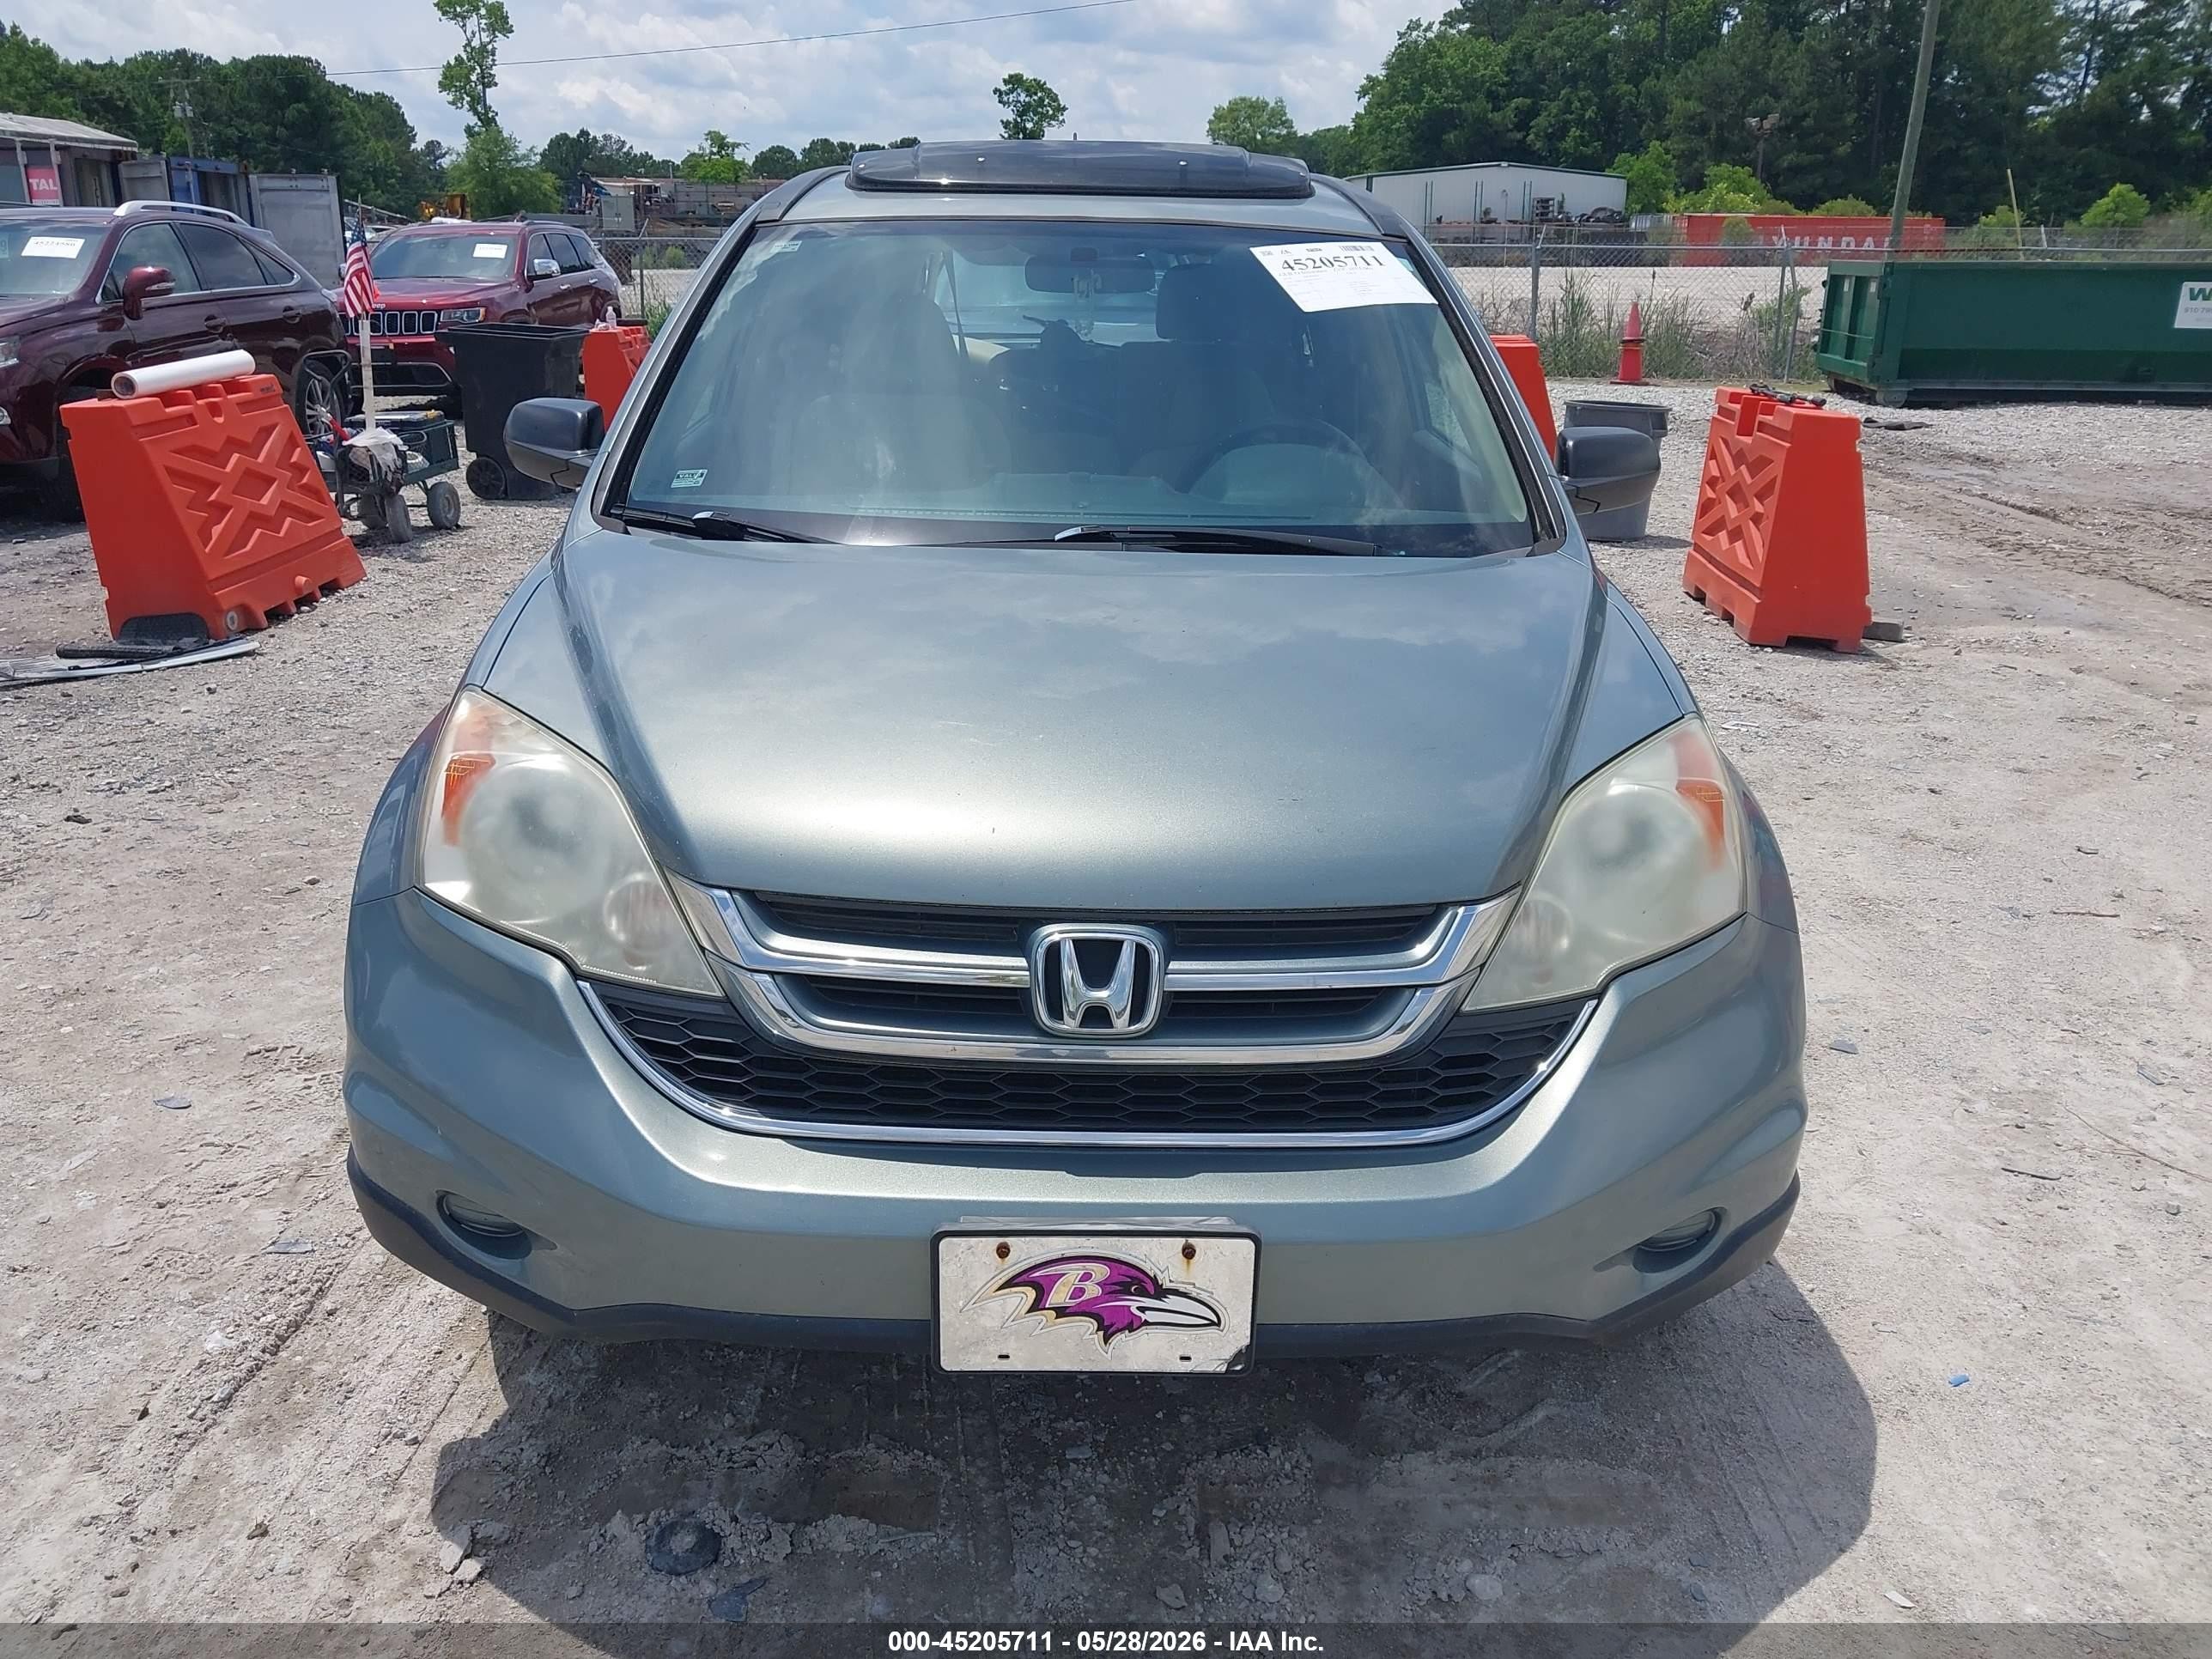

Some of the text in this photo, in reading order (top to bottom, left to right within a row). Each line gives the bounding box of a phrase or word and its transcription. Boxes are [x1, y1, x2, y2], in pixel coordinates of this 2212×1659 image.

[29, 178, 58, 191] TAL
[1281, 255, 1386, 271] 45205711
[1028, 1262, 1111, 1309] B
